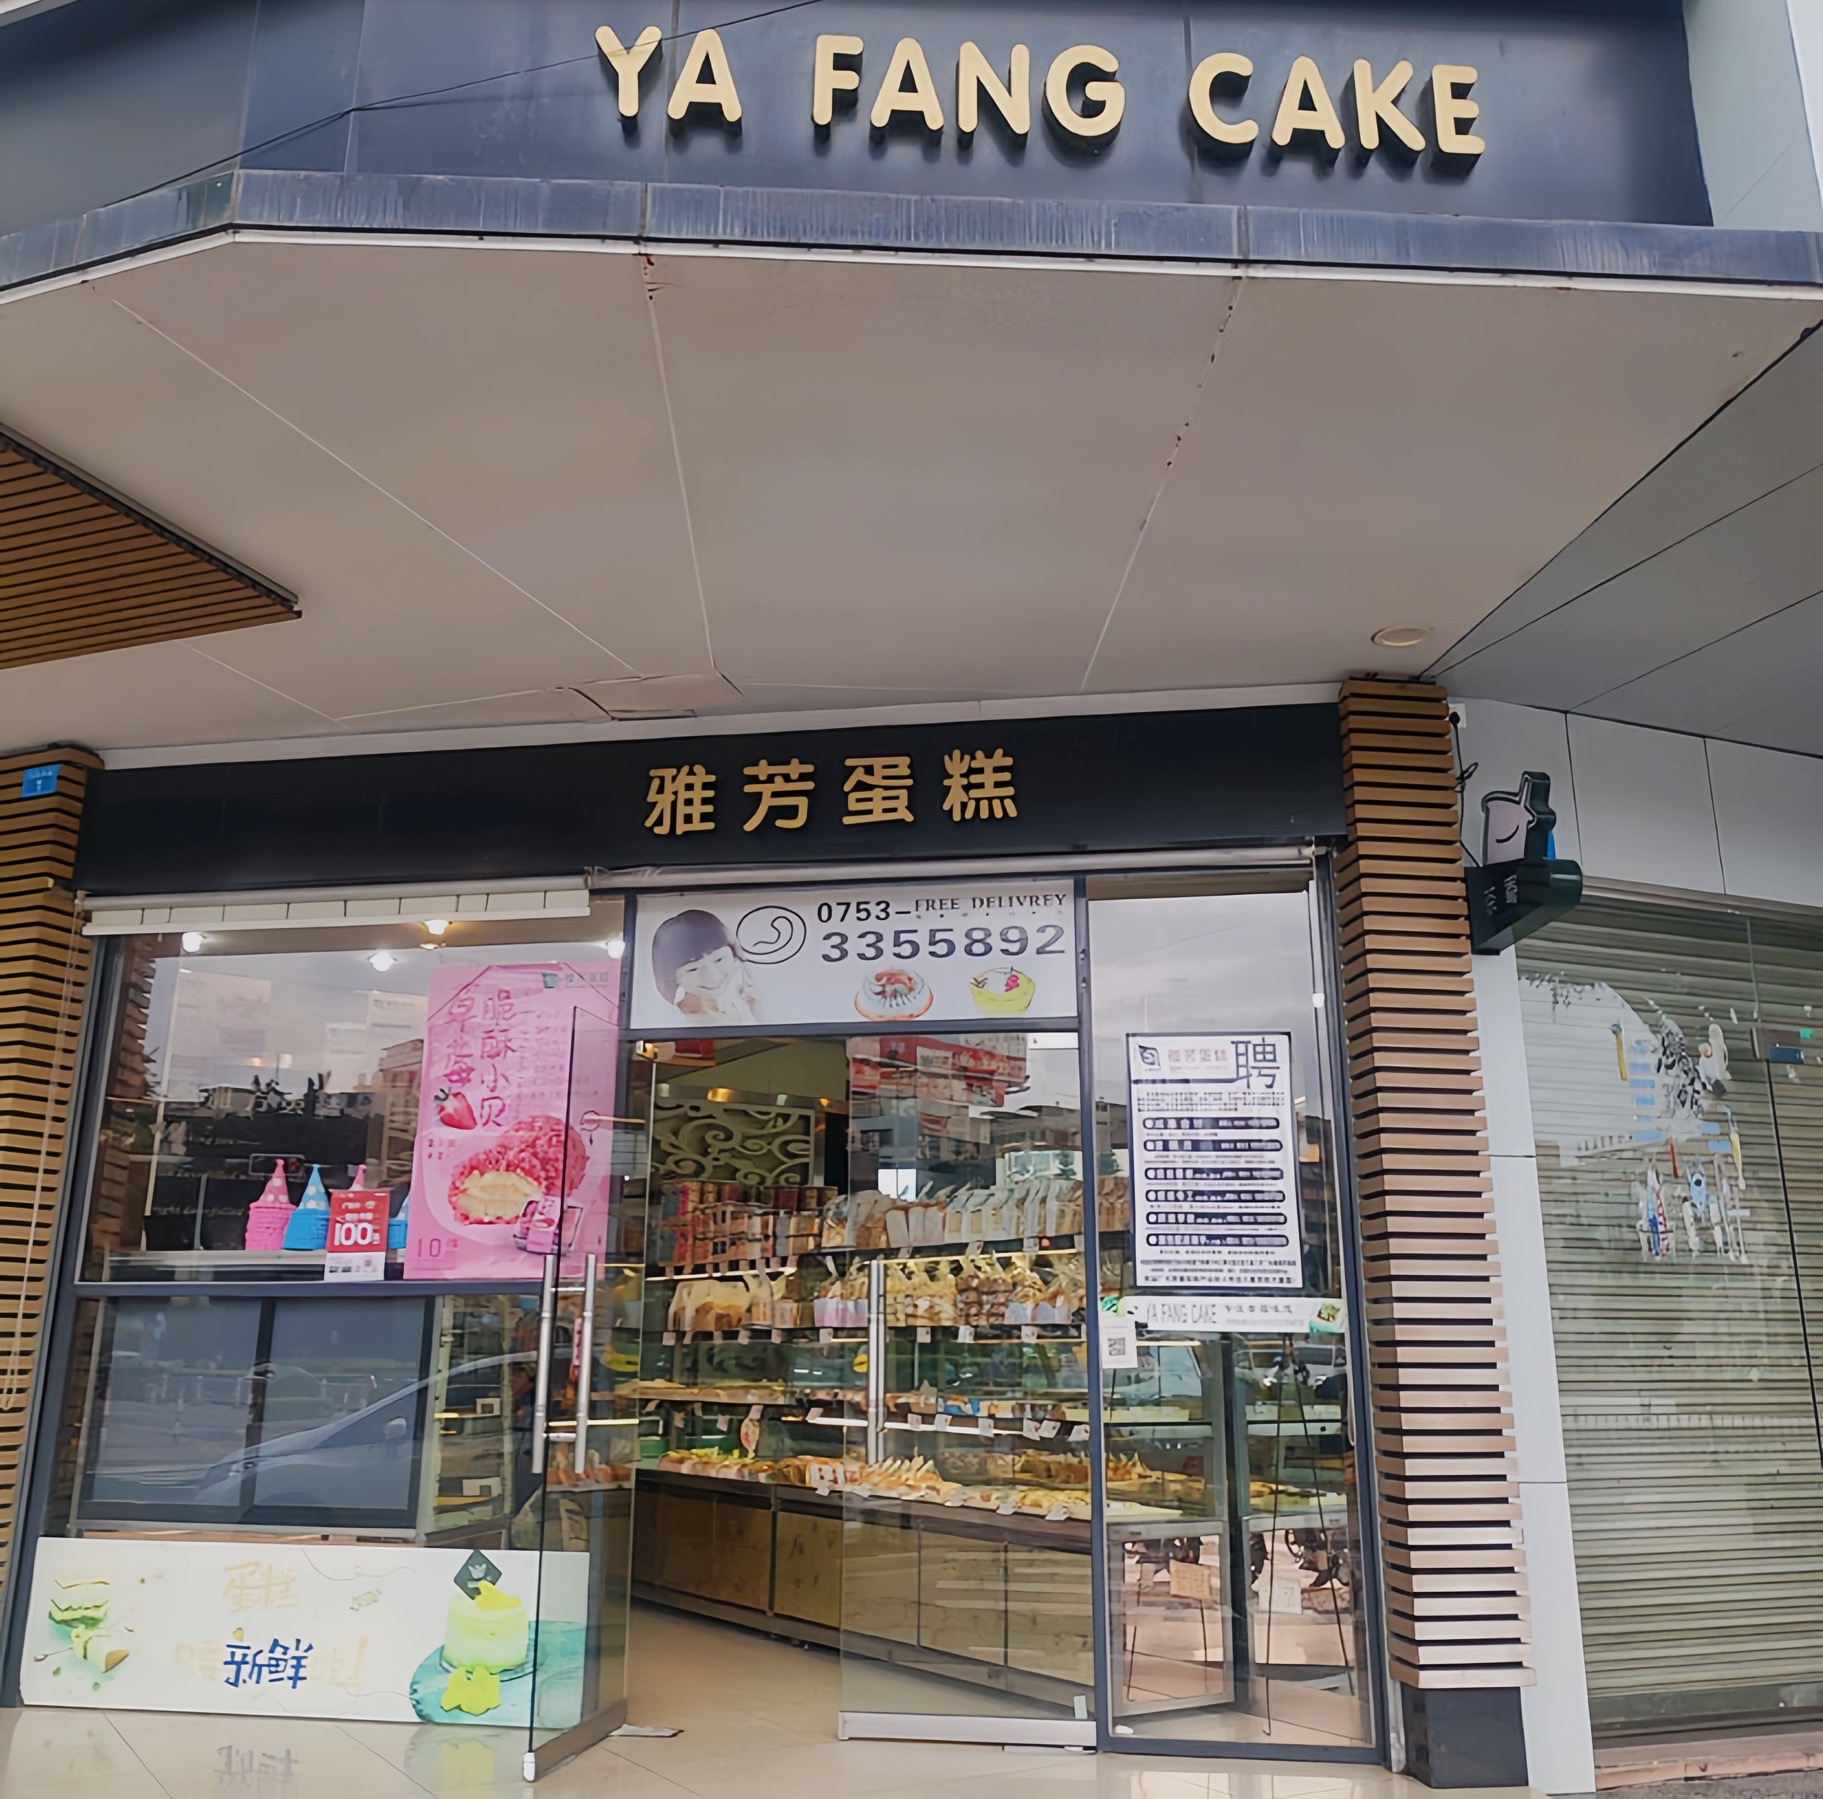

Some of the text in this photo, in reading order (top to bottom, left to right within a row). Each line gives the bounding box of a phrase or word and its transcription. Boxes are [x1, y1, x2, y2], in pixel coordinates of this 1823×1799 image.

[594, 26, 1487, 155] YA FANG CAKE
[644, 748, 1019, 836] 雅芳蛋糕
[915, 898, 960, 912] FREE
[821, 924, 1066, 963] 3355892
[1230, 1036, 1281, 1089] 聘
[333, 1222, 374, 1247] 100
[223, 1637, 314, 1690] 新鲜
